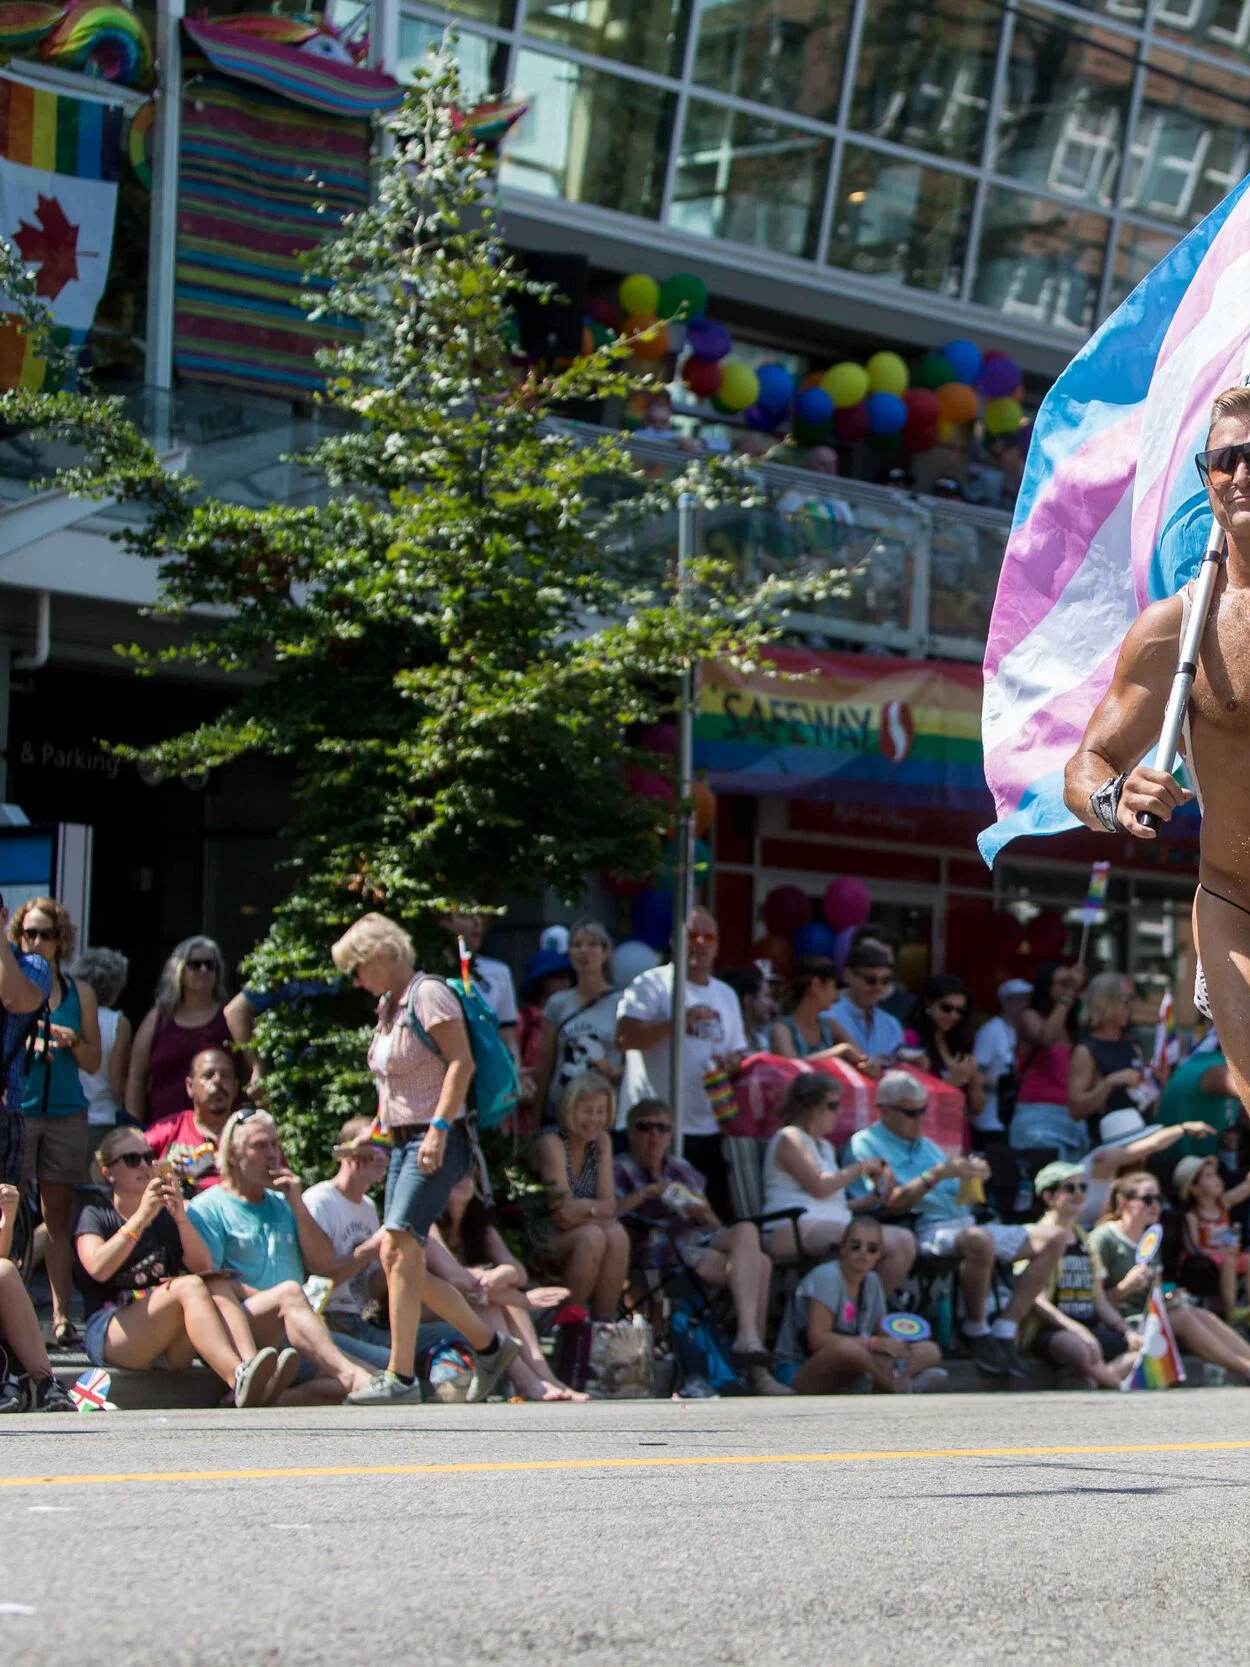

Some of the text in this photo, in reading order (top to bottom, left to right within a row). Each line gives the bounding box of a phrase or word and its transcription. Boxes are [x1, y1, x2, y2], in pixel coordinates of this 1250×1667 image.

[722, 691, 873, 750] SAFEWAY
[20, 740, 121, 780] & Parking
